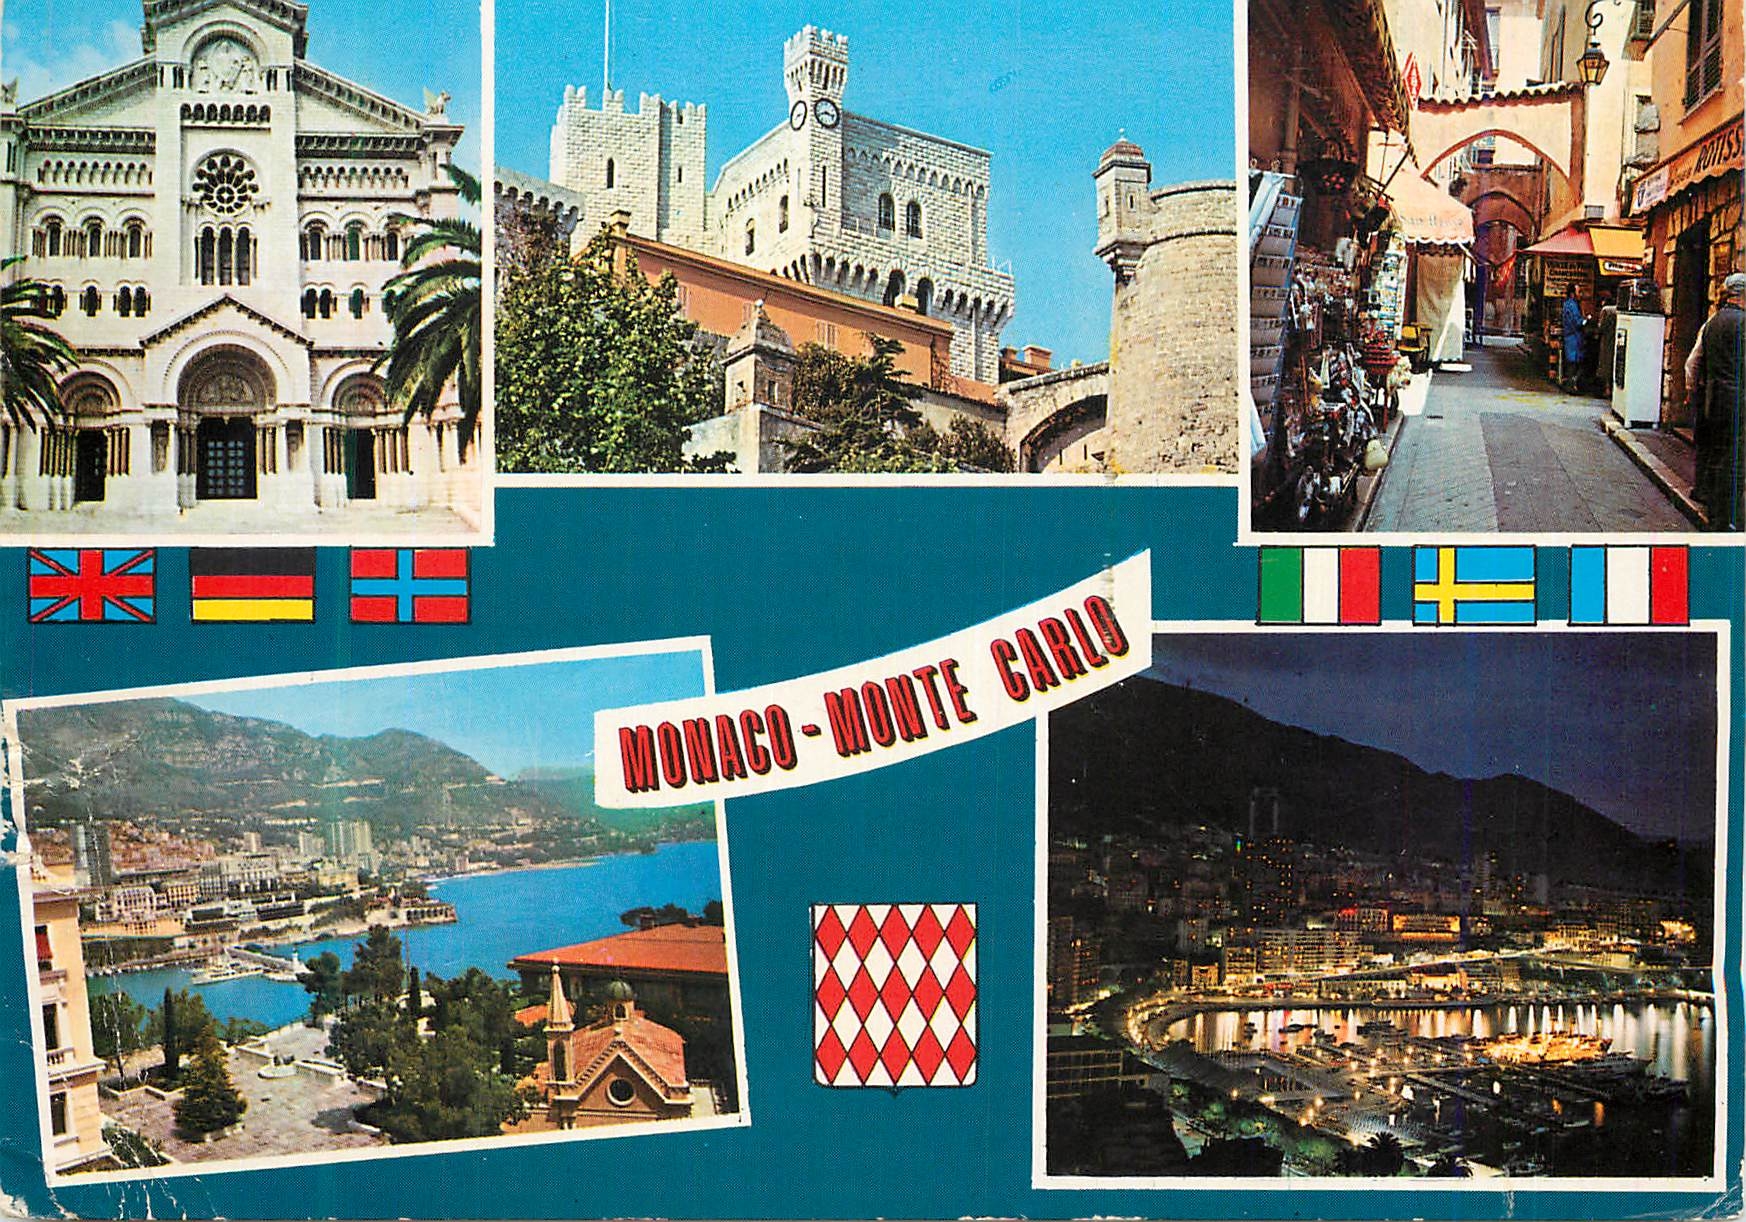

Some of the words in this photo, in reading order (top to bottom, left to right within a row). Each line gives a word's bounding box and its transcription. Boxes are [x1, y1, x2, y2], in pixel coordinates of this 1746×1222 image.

[1694, 124, 1744, 175] ROTISS
[618, 704, 799, 795] MONACO
[824, 658, 979, 759] MONTE
[990, 595, 1130, 703] CARLO
